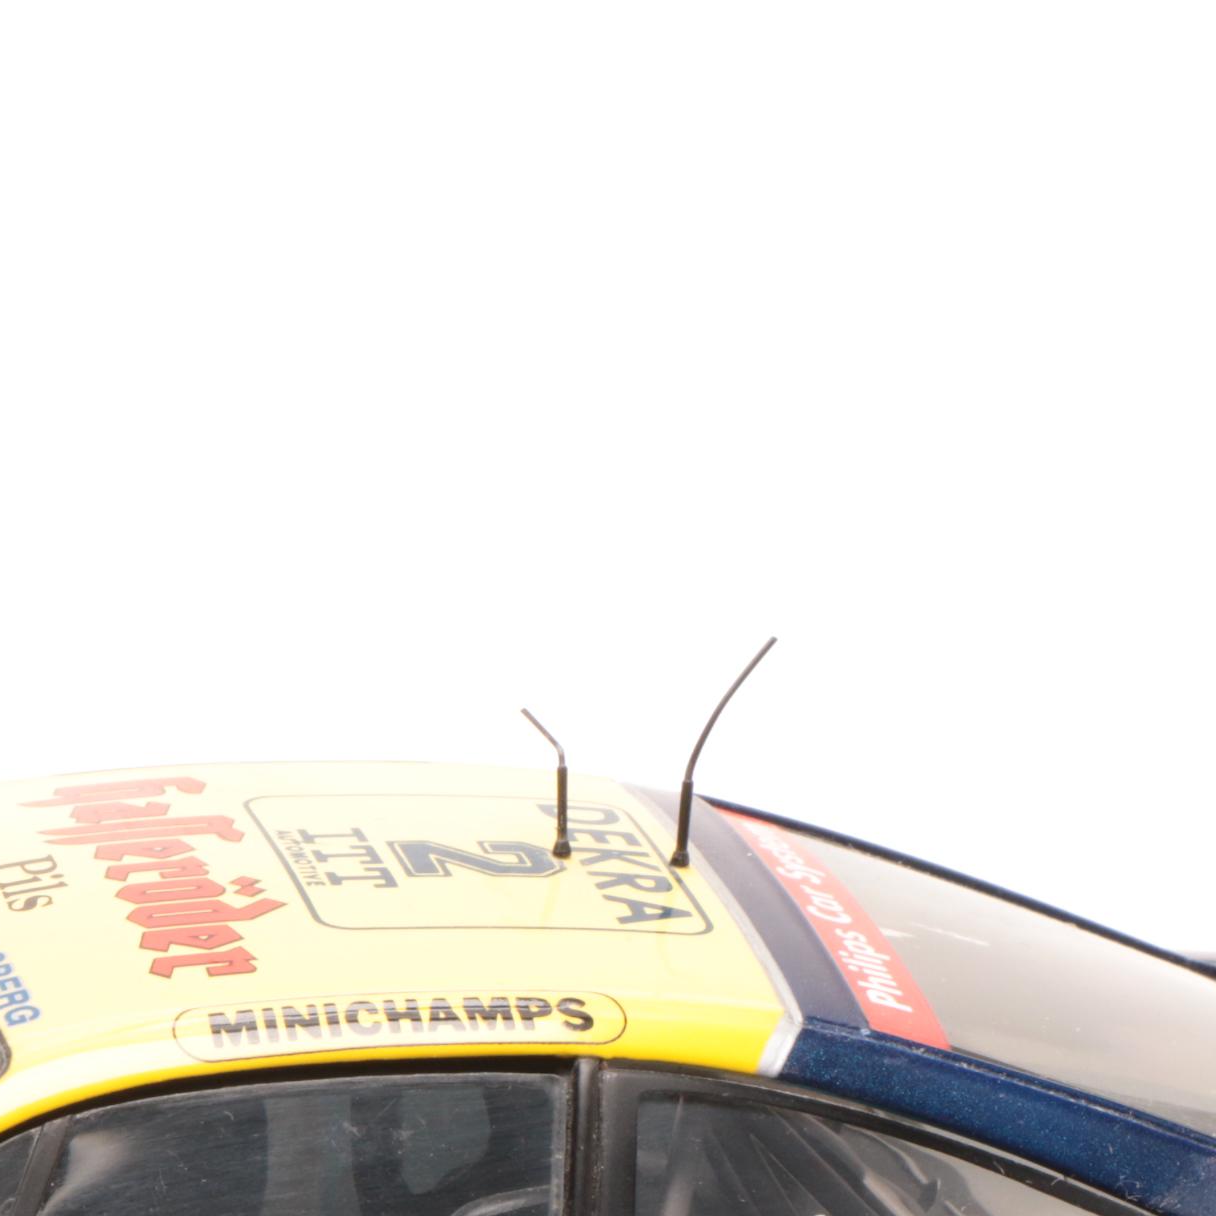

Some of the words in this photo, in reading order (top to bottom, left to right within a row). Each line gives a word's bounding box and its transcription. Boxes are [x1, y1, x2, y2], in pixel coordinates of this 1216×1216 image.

[275, 828, 326, 887] AUTOMOTIVE
[296, 826, 399, 888] ITT
[385, 839, 566, 878] 2
[536, 803, 693, 925] DEKRA
[800, 881, 851, 923] Car
[835, 926, 913, 1013] Philips
[207, 997, 596, 1050] MINICHAMPS
